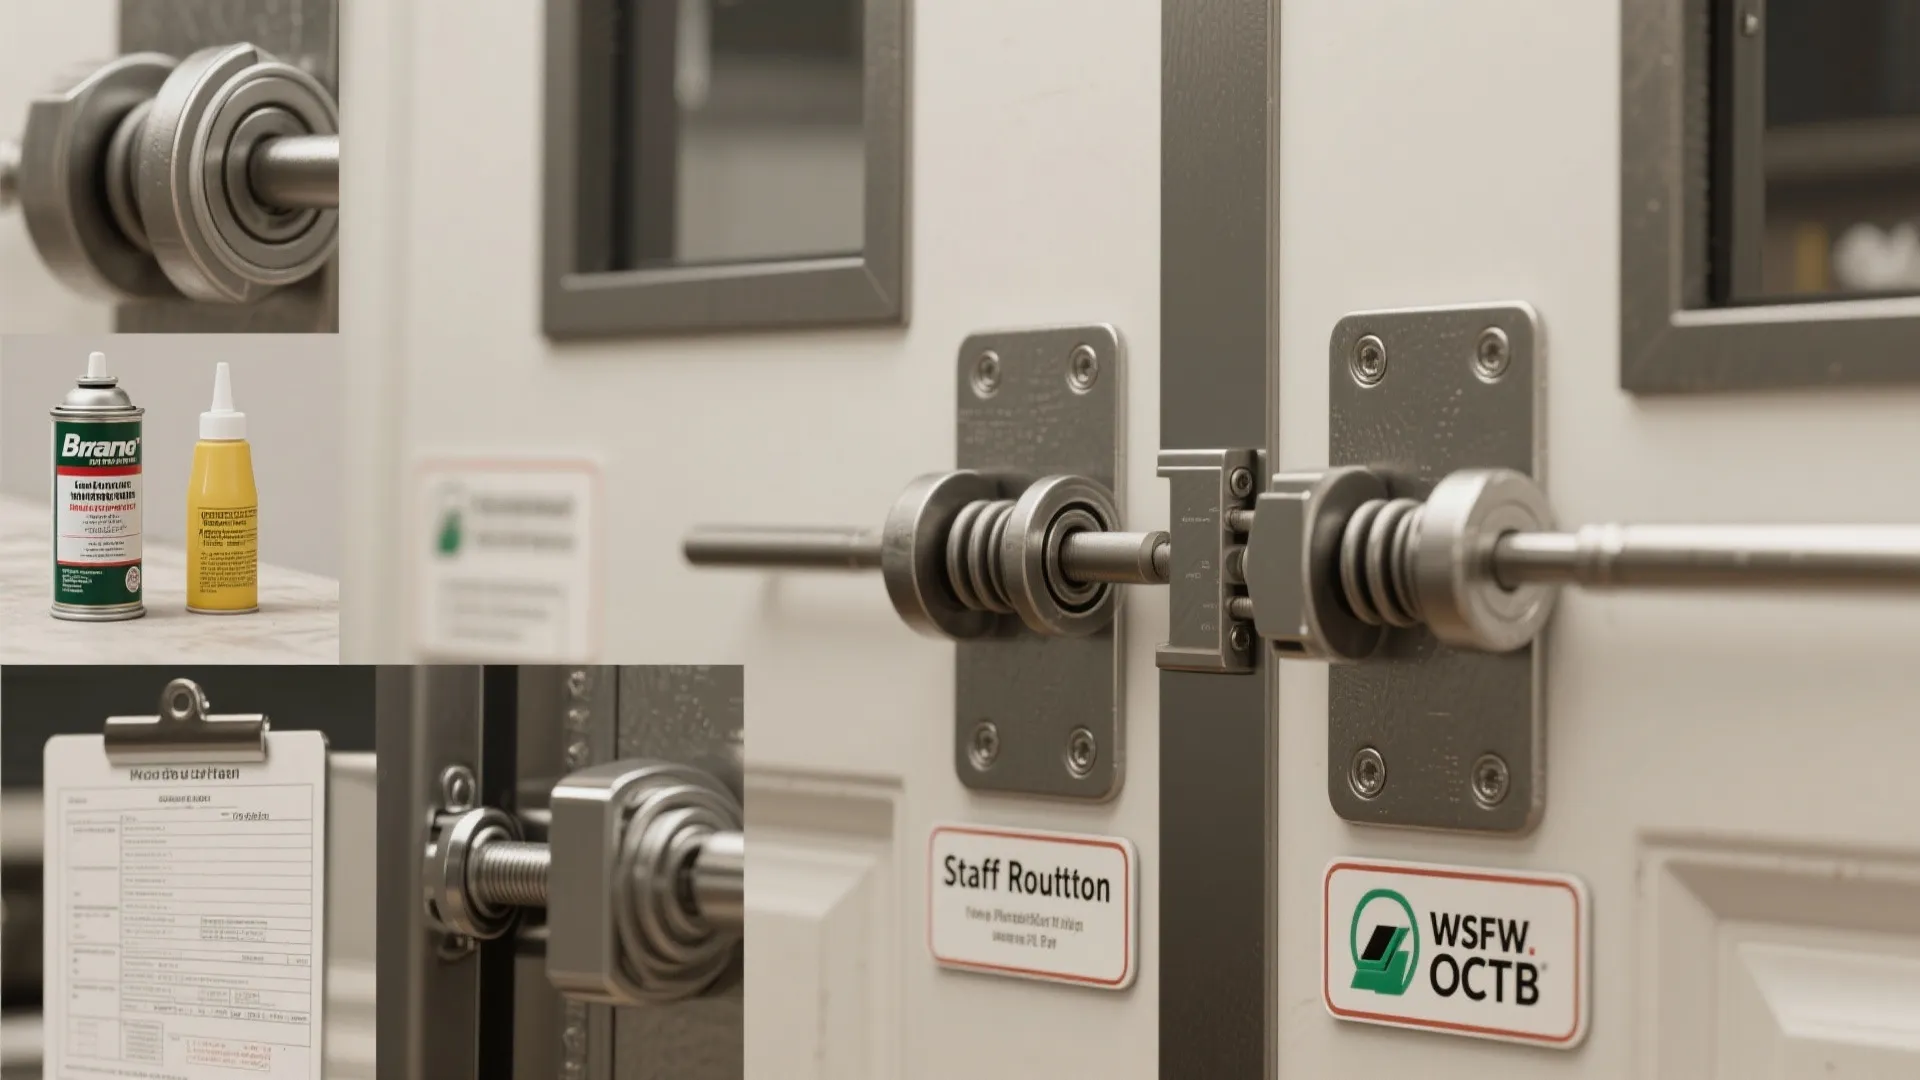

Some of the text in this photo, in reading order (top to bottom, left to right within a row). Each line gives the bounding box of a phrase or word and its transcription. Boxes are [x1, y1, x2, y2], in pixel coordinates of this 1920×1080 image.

[944, 854, 1111, 903] Staff Routtton
[1429, 953, 1541, 1006] OCTB
